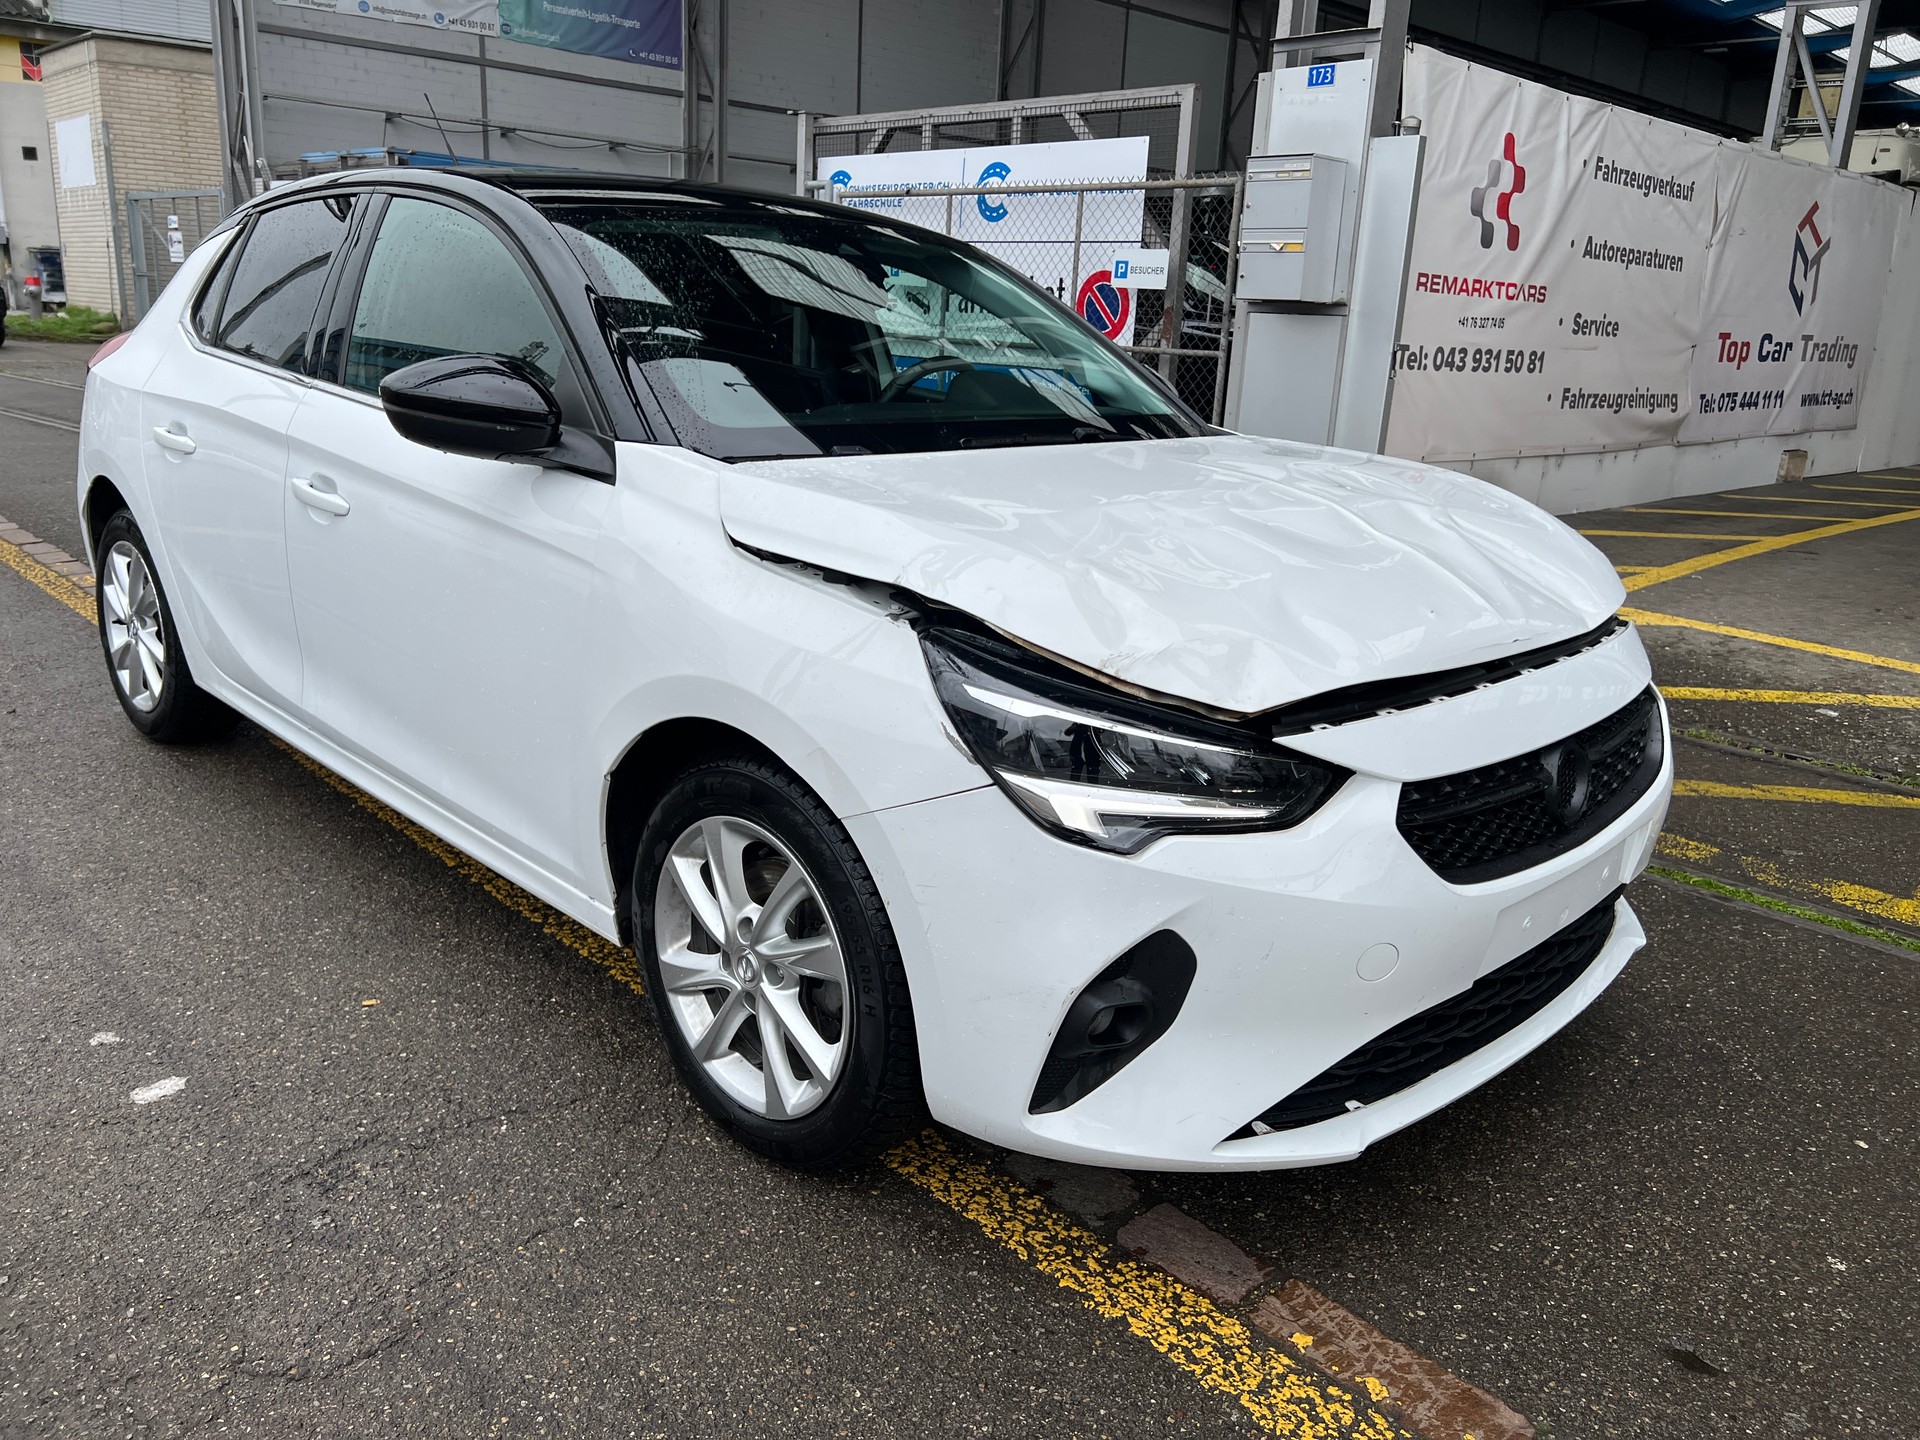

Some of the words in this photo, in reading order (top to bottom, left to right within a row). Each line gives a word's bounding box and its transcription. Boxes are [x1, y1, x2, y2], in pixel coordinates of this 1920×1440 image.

[459, 19, 467, 27] 43
[467, 20, 478, 29] 931
[1311, 67, 1332, 84] 173
[1593, 155, 1696, 202] Fahrzeugverkauf
[848, 198, 903, 208] FAHRSCHULE
[1582, 235, 1684, 272] Autoreparaturen
[1130, 265, 1165, 275] BESUCHER
[1415, 272, 1548, 303] REMARKTCARS
[1458, 316, 1469, 328] +41
[1470, 316, 1478, 328] 76
[1478, 317, 1490, 329] 327
[1490, 317, 1498, 329] 74
[1571, 312, 1620, 337] Service
[1397, 343, 1428, 371] Tel:
[1432, 346, 1468, 372] 043
[1471, 348, 1502, 373] 931
[1503, 349, 1525, 374] 50
[1526, 350, 1546, 374] 81
[1717, 332, 1751, 370] Top
[1757, 333, 1793, 363] Car
[1800, 334, 1859, 369] Trading
[1560, 386, 1679, 414] Fahrzeugreinigung
[1699, 393, 1716, 414] Tel:
[1717, 391, 1738, 413] 075
[1738, 390, 1760, 411] 444
[1762, 390, 1773, 410] 11
[1773, 389, 1785, 409] 11
